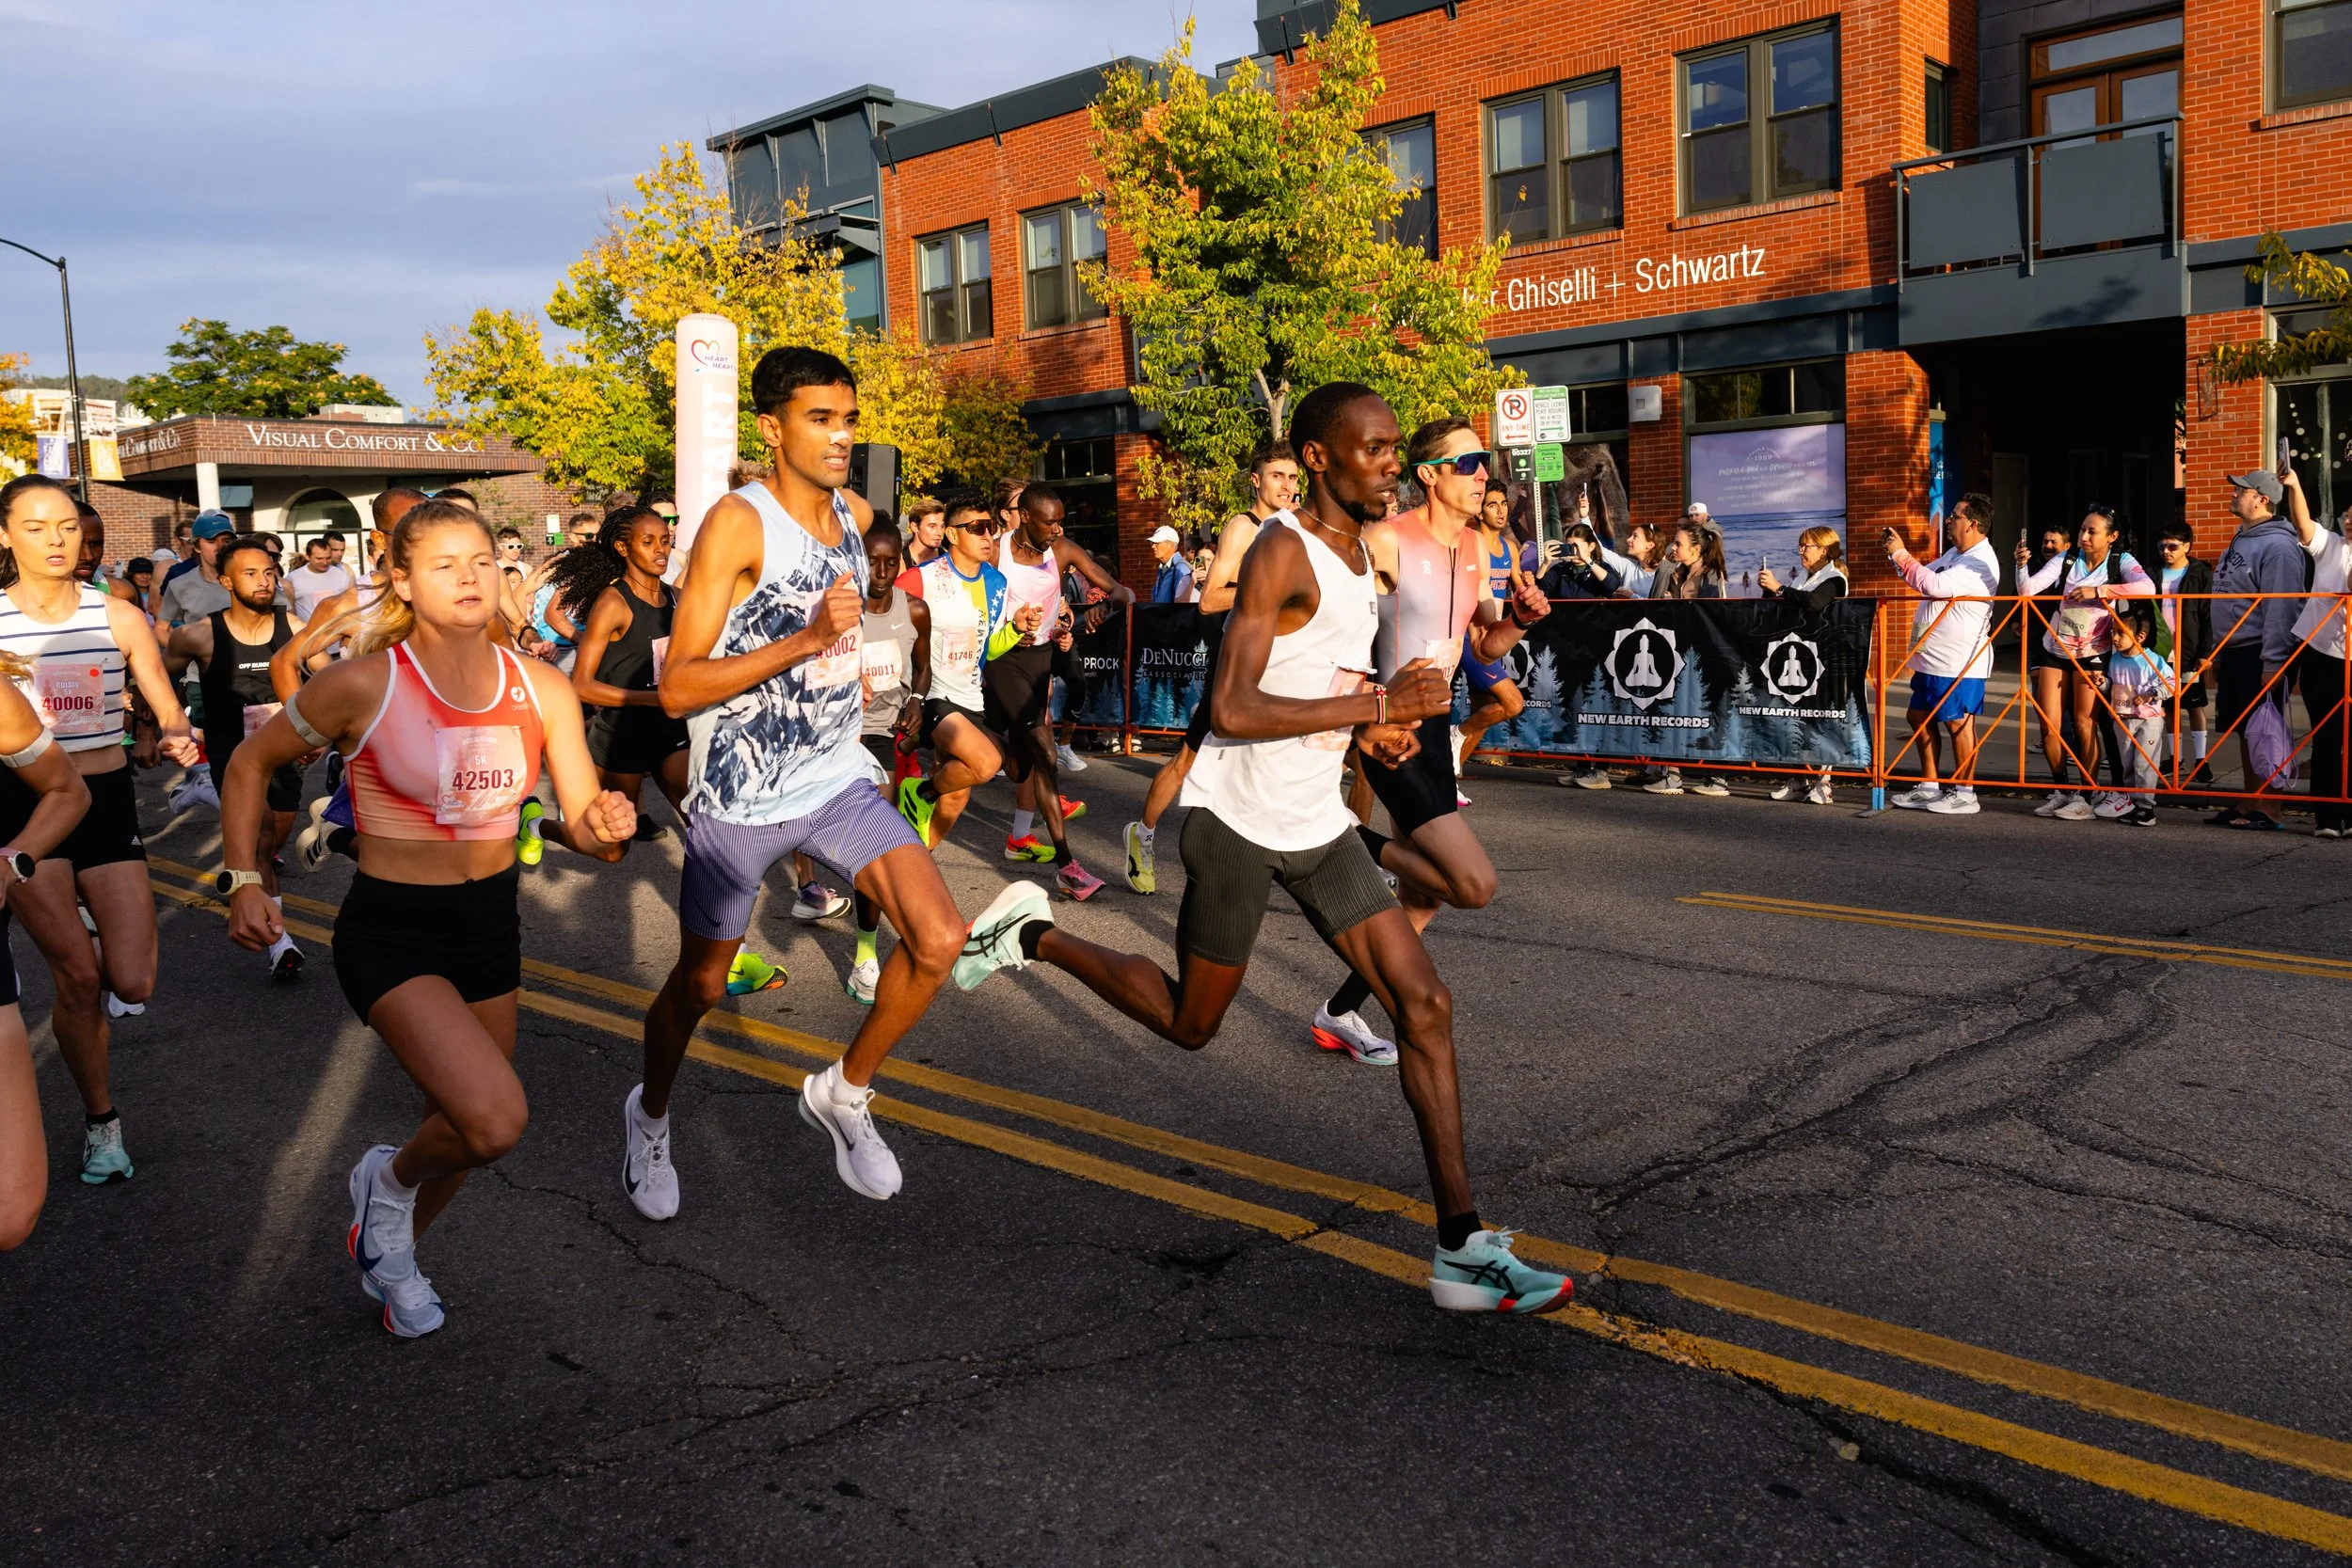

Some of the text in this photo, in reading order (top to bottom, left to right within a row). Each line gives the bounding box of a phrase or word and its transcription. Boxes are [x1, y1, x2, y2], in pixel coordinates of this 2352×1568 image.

[1507, 267, 1596, 311] Ghiselli
[1604, 272, 1626, 297] +
[1635, 244, 1765, 293] Schwartz
[246, 424, 321, 448] VISUAL
[326, 428, 419, 451] COMFORT
[425, 432, 446, 452] &
[948, 651, 973, 661] 41746
[1084, 657, 1120, 670] PROCK
[866, 664, 895, 677] 40011
[42, 696, 94, 710] 40006
[1522, 700, 1551, 708] ECORDS
[1739, 706, 1846, 719] NEW EARTH RECORDS
[1578, 714, 1710, 728] NEW EARTH RECORDS
[475, 754, 487, 766] 5K
[453, 768, 514, 791] 42503
